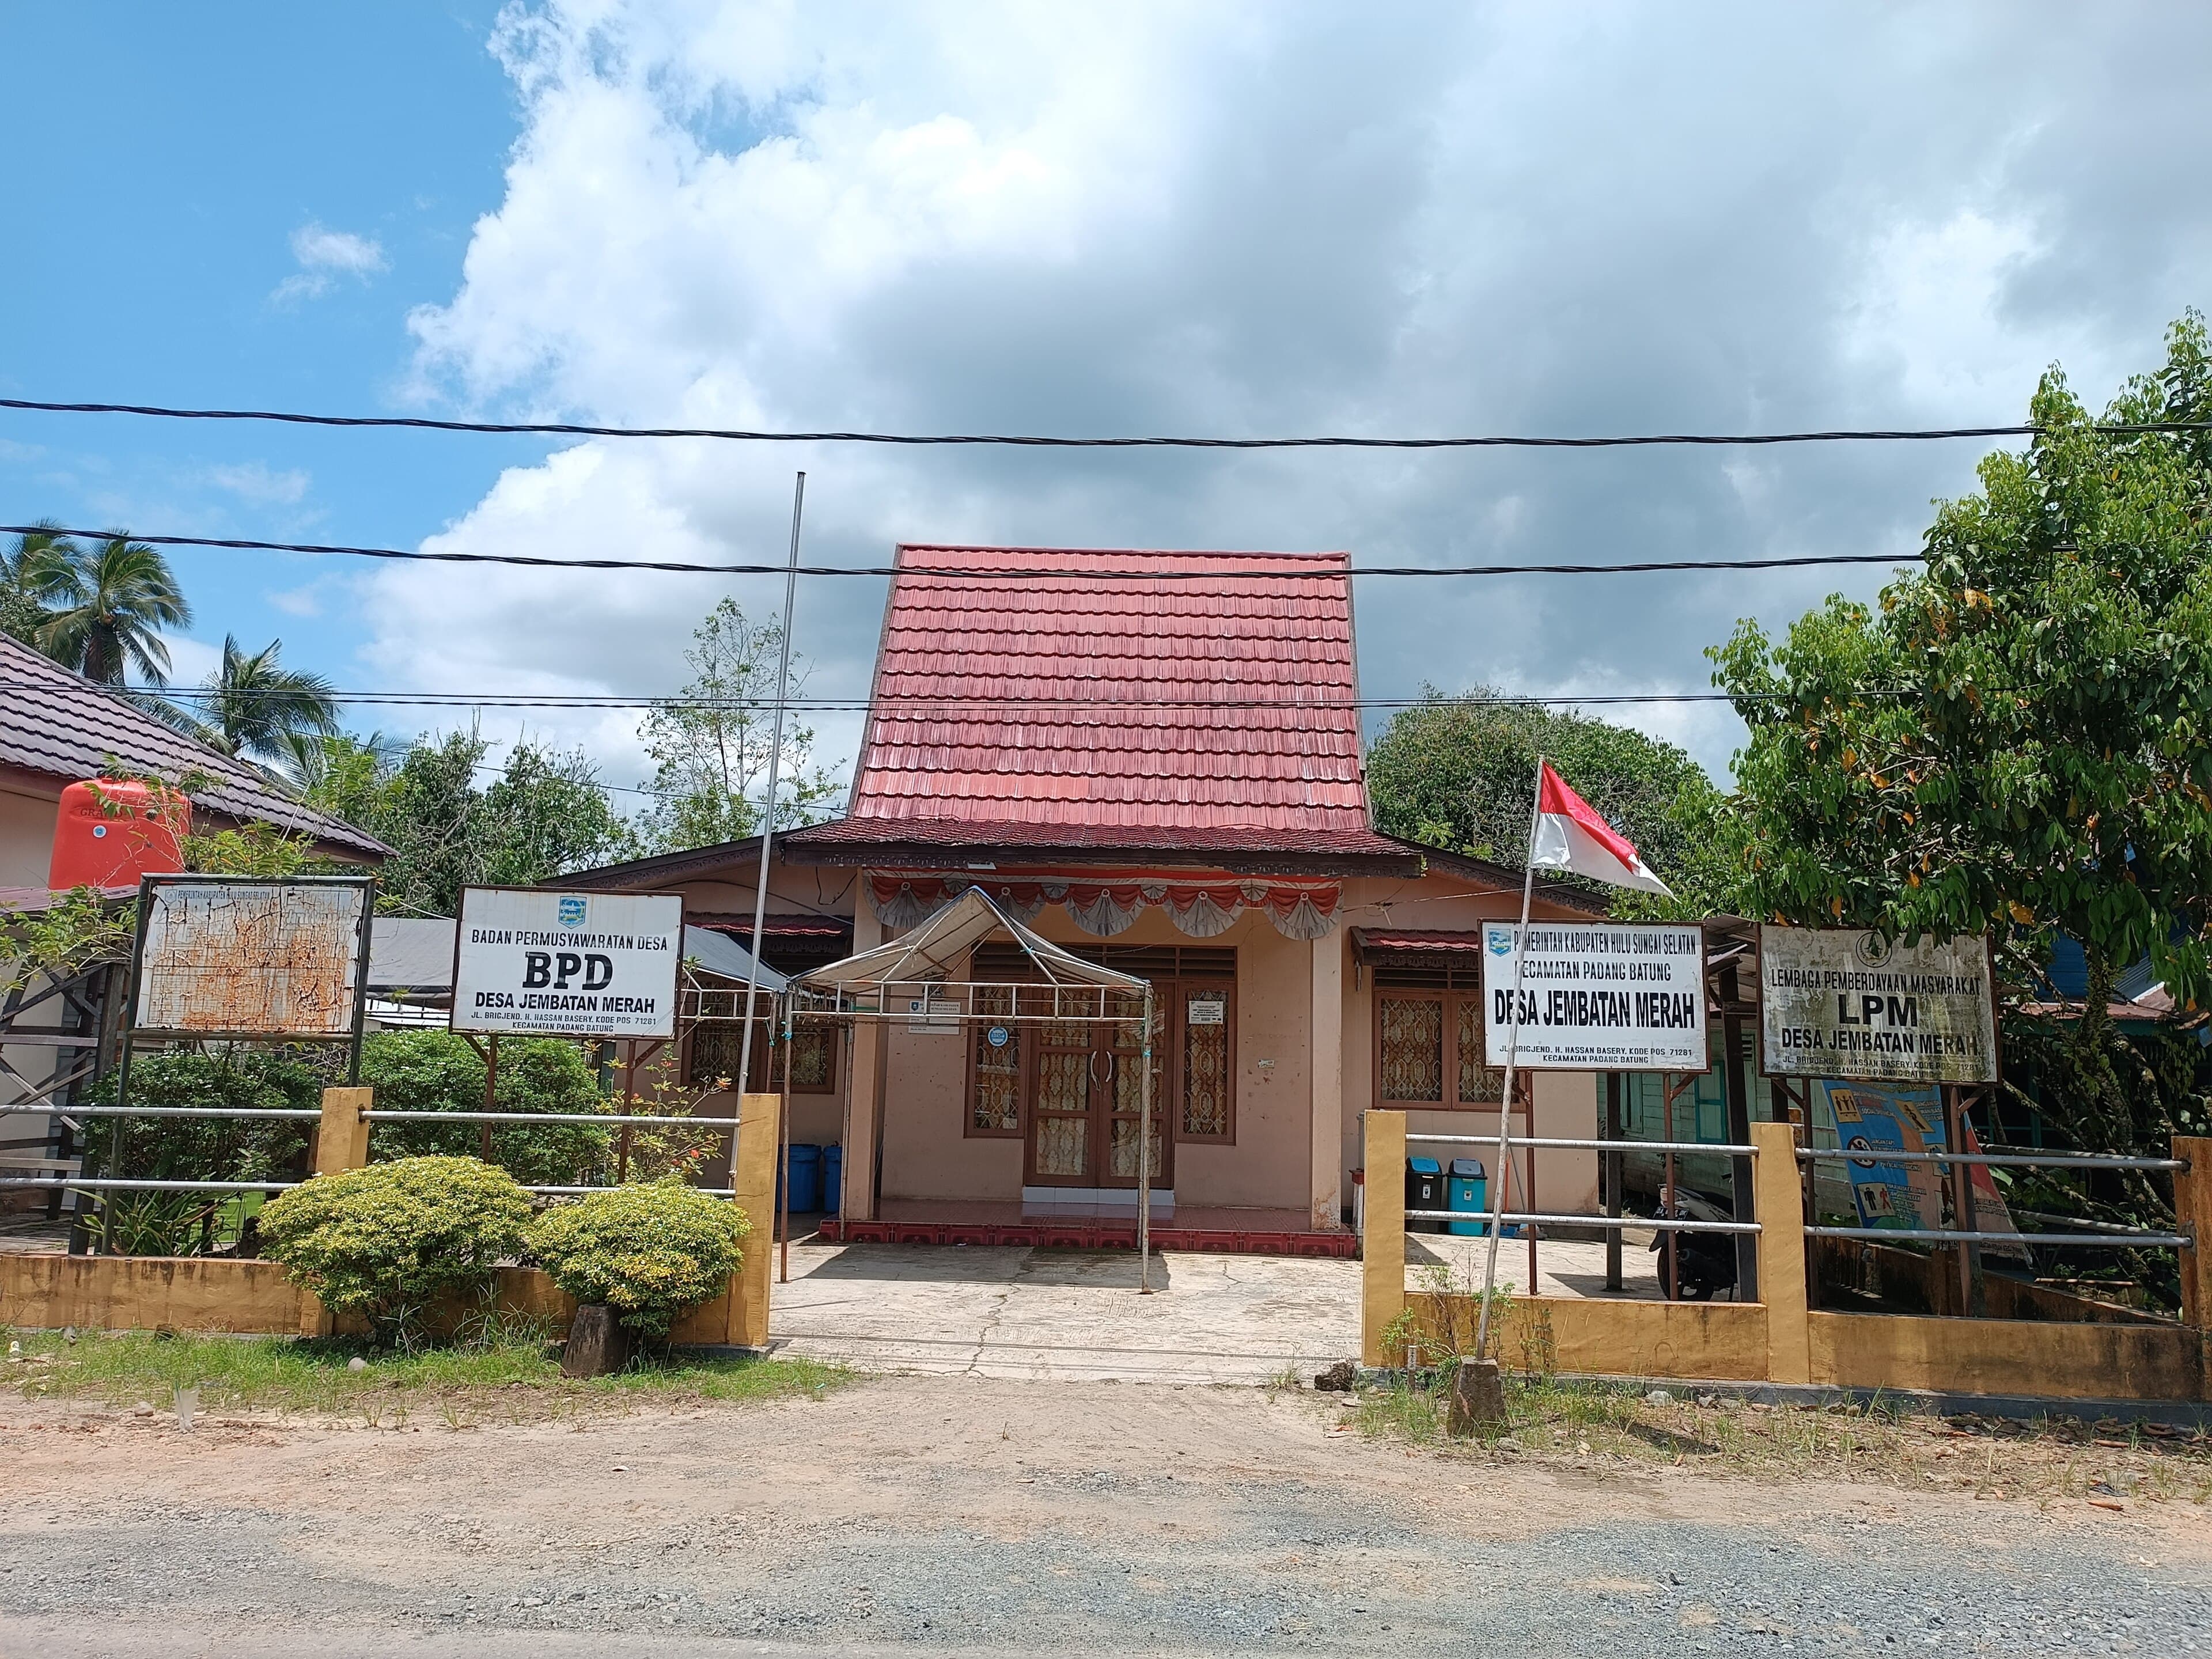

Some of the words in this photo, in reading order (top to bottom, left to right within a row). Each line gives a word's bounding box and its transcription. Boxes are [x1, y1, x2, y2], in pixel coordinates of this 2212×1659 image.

[81, 809, 122, 817] GRAD
[178, 891, 203, 899] PEMERINTAH
[203, 891, 225, 899] KABUPATEN
[472, 930, 512, 944] BADAN
[516, 931, 633, 949] PERMUSYAWARATAN
[638, 936, 667, 950] DESA
[1514, 931, 1562, 952] PMERINTAH
[1565, 931, 1609, 953] KABUPATEN
[1611, 933, 1630, 954] HULU
[1633, 933, 1661, 955] SUNGAI
[1664, 934, 1695, 955] SELATAN
[522, 952, 613, 990] BPD
[1515, 961, 1579, 979] ECAMATAN
[1584, 962, 1626, 980] PADANG
[1630, 963, 1671, 981] BATUNG
[1771, 969, 1820, 988] LEMBAGA
[1825, 971, 1907, 993] PEMBERDAYAAN
[1911, 975, 1980, 995] MASYARAKAT
[476, 993, 514, 1007] DESA
[519, 994, 597, 1010] JEMBATAN
[603, 997, 654, 1013] MERAH
[1495, 989, 1538, 1025] DESA
[1543, 990, 1630, 1027] JEMBATAN
[1635, 992, 1694, 1028] MERAH
[1838, 994, 1918, 1027] LPM
[1782, 1028, 1823, 1048] DESA
[1828, 1031, 1913, 1052] JEMBATAN
[1920, 1034, 1977, 1055] MERAH
[1827, 1067, 1871, 1075] KECAMATAN
[1873, 1069, 1902, 1077] PADANG
